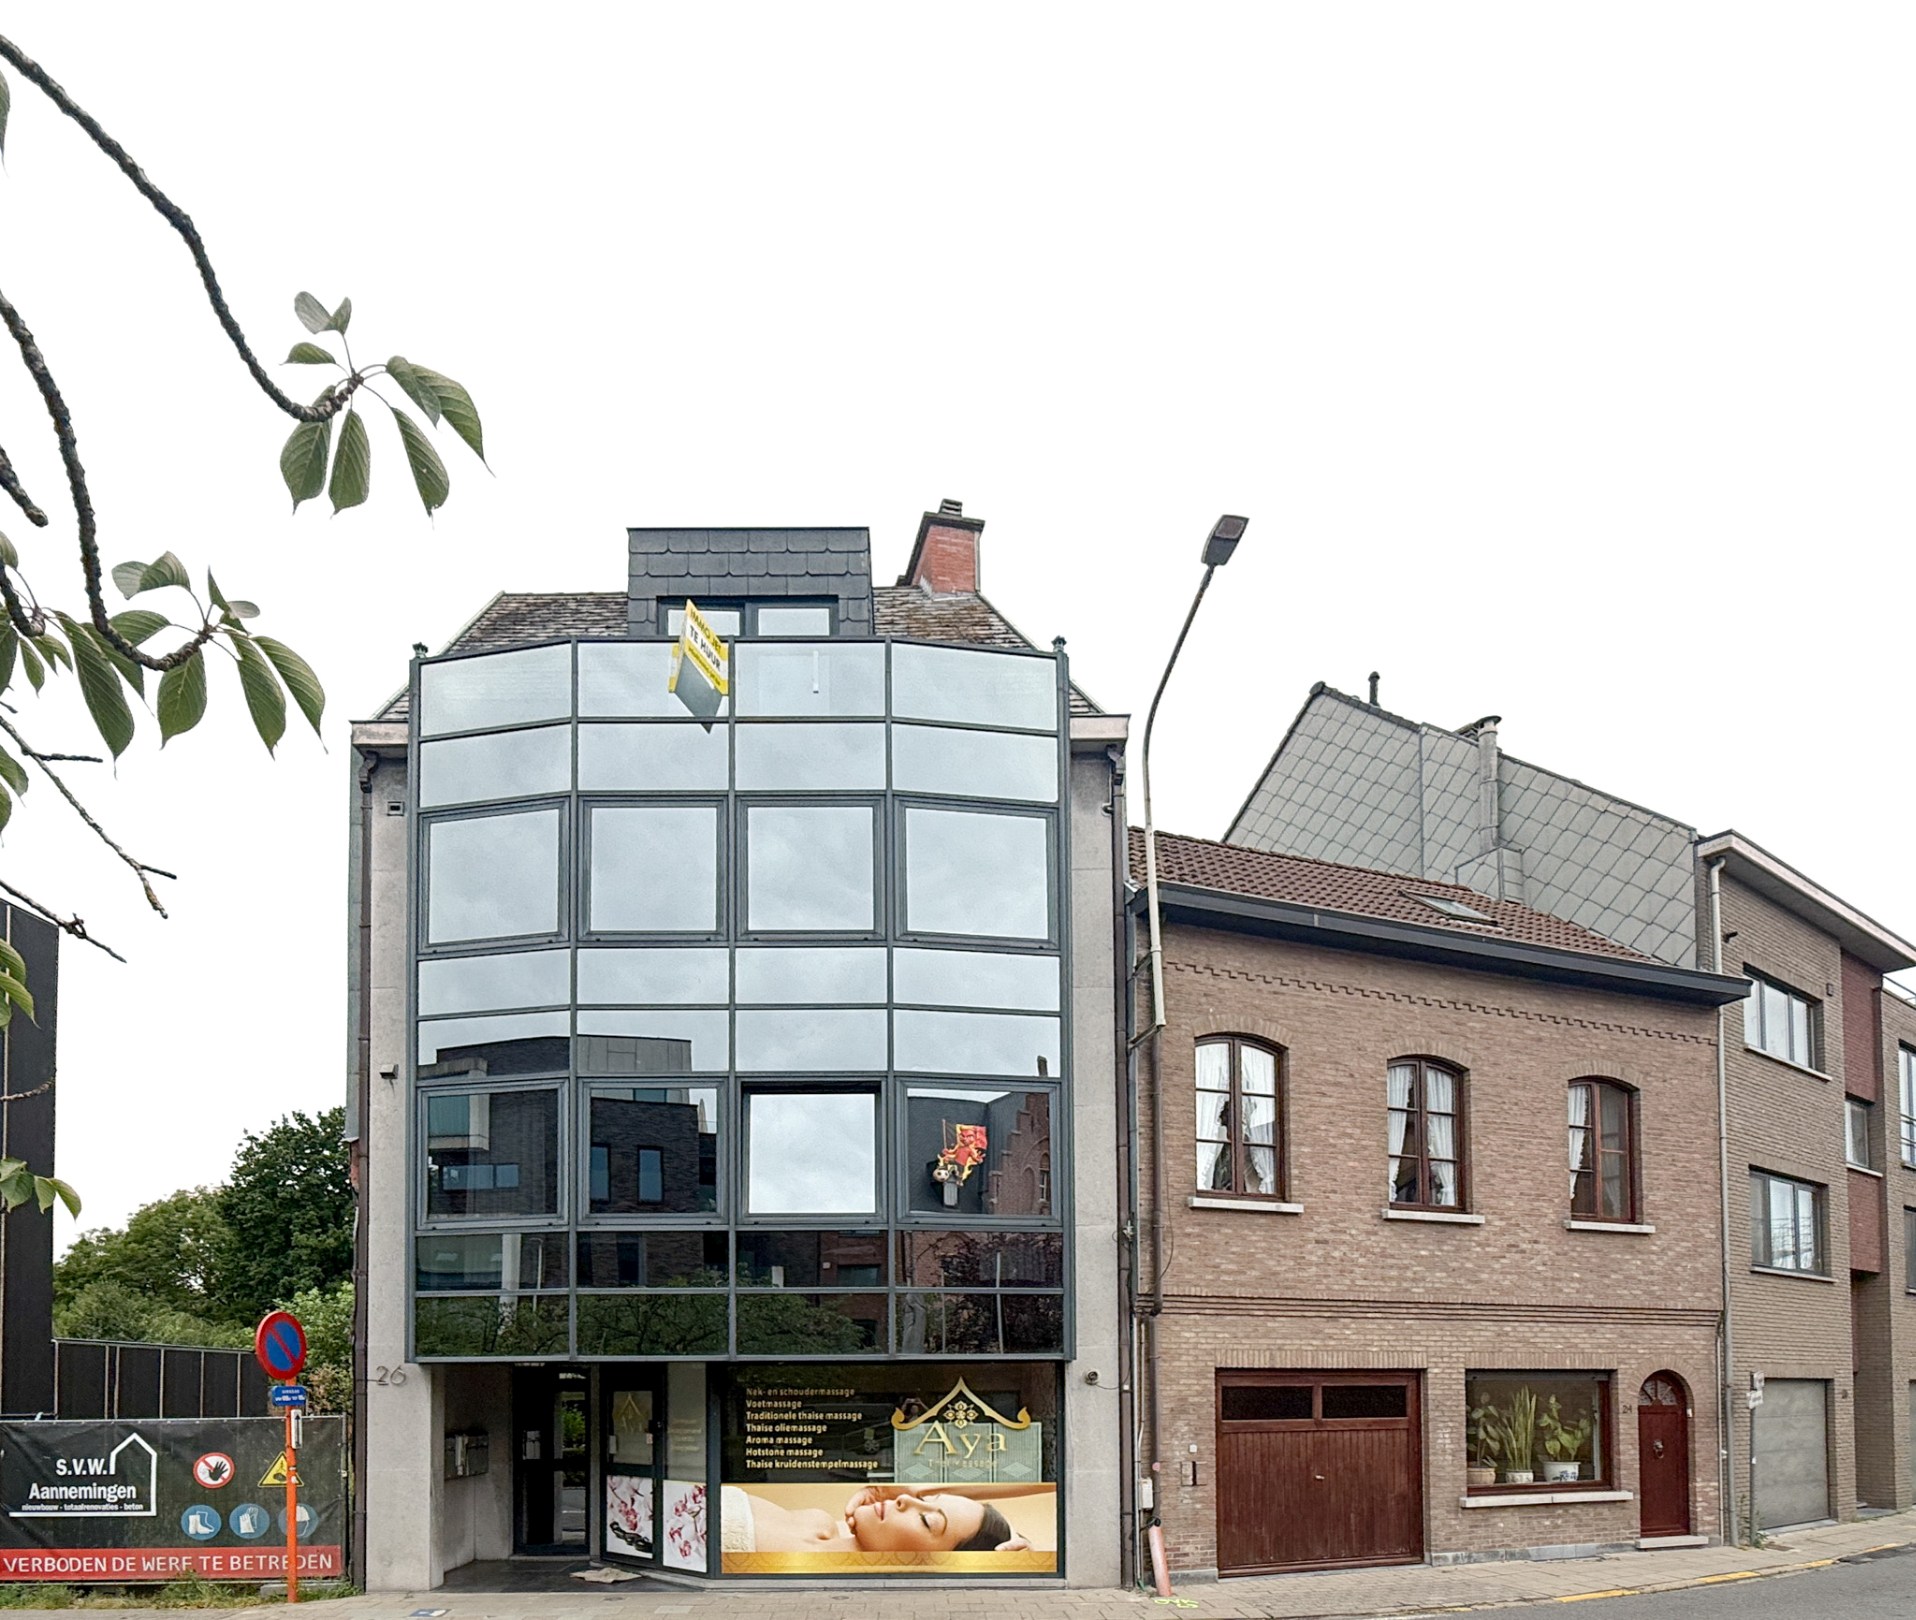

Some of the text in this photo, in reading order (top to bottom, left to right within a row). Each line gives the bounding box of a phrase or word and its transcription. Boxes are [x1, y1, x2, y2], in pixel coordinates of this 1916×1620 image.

[689, 625, 699, 643] TE
[700, 642, 721, 671] HUUR
[376, 1364, 406, 1386] 26
[779, 1387, 855, 1398] schoudermassage
[746, 1400, 802, 1409] Voetmassage
[746, 1411, 863, 1422] Traditionele thaise massage
[746, 1423, 827, 1434] Thaise oliemassage
[745, 1435, 813, 1446] Aroma massage
[913, 1420, 1007, 1459] Aya
[745, 1448, 824, 1458] Hotstone massage
[56, 1458, 107, 1476] S.V.W.
[745, 1459, 879, 1470] Thaise kruidenstempelmassage
[28, 1482, 137, 1503] Aannemingen
[124, 1503, 143, 1511] beton
[3, 1557, 107, 1572] VERBODEN
[112, 1557, 136, 1571] DE
[142, 1556, 192, 1571] WERF
[198, 1556, 223, 1570] TE
